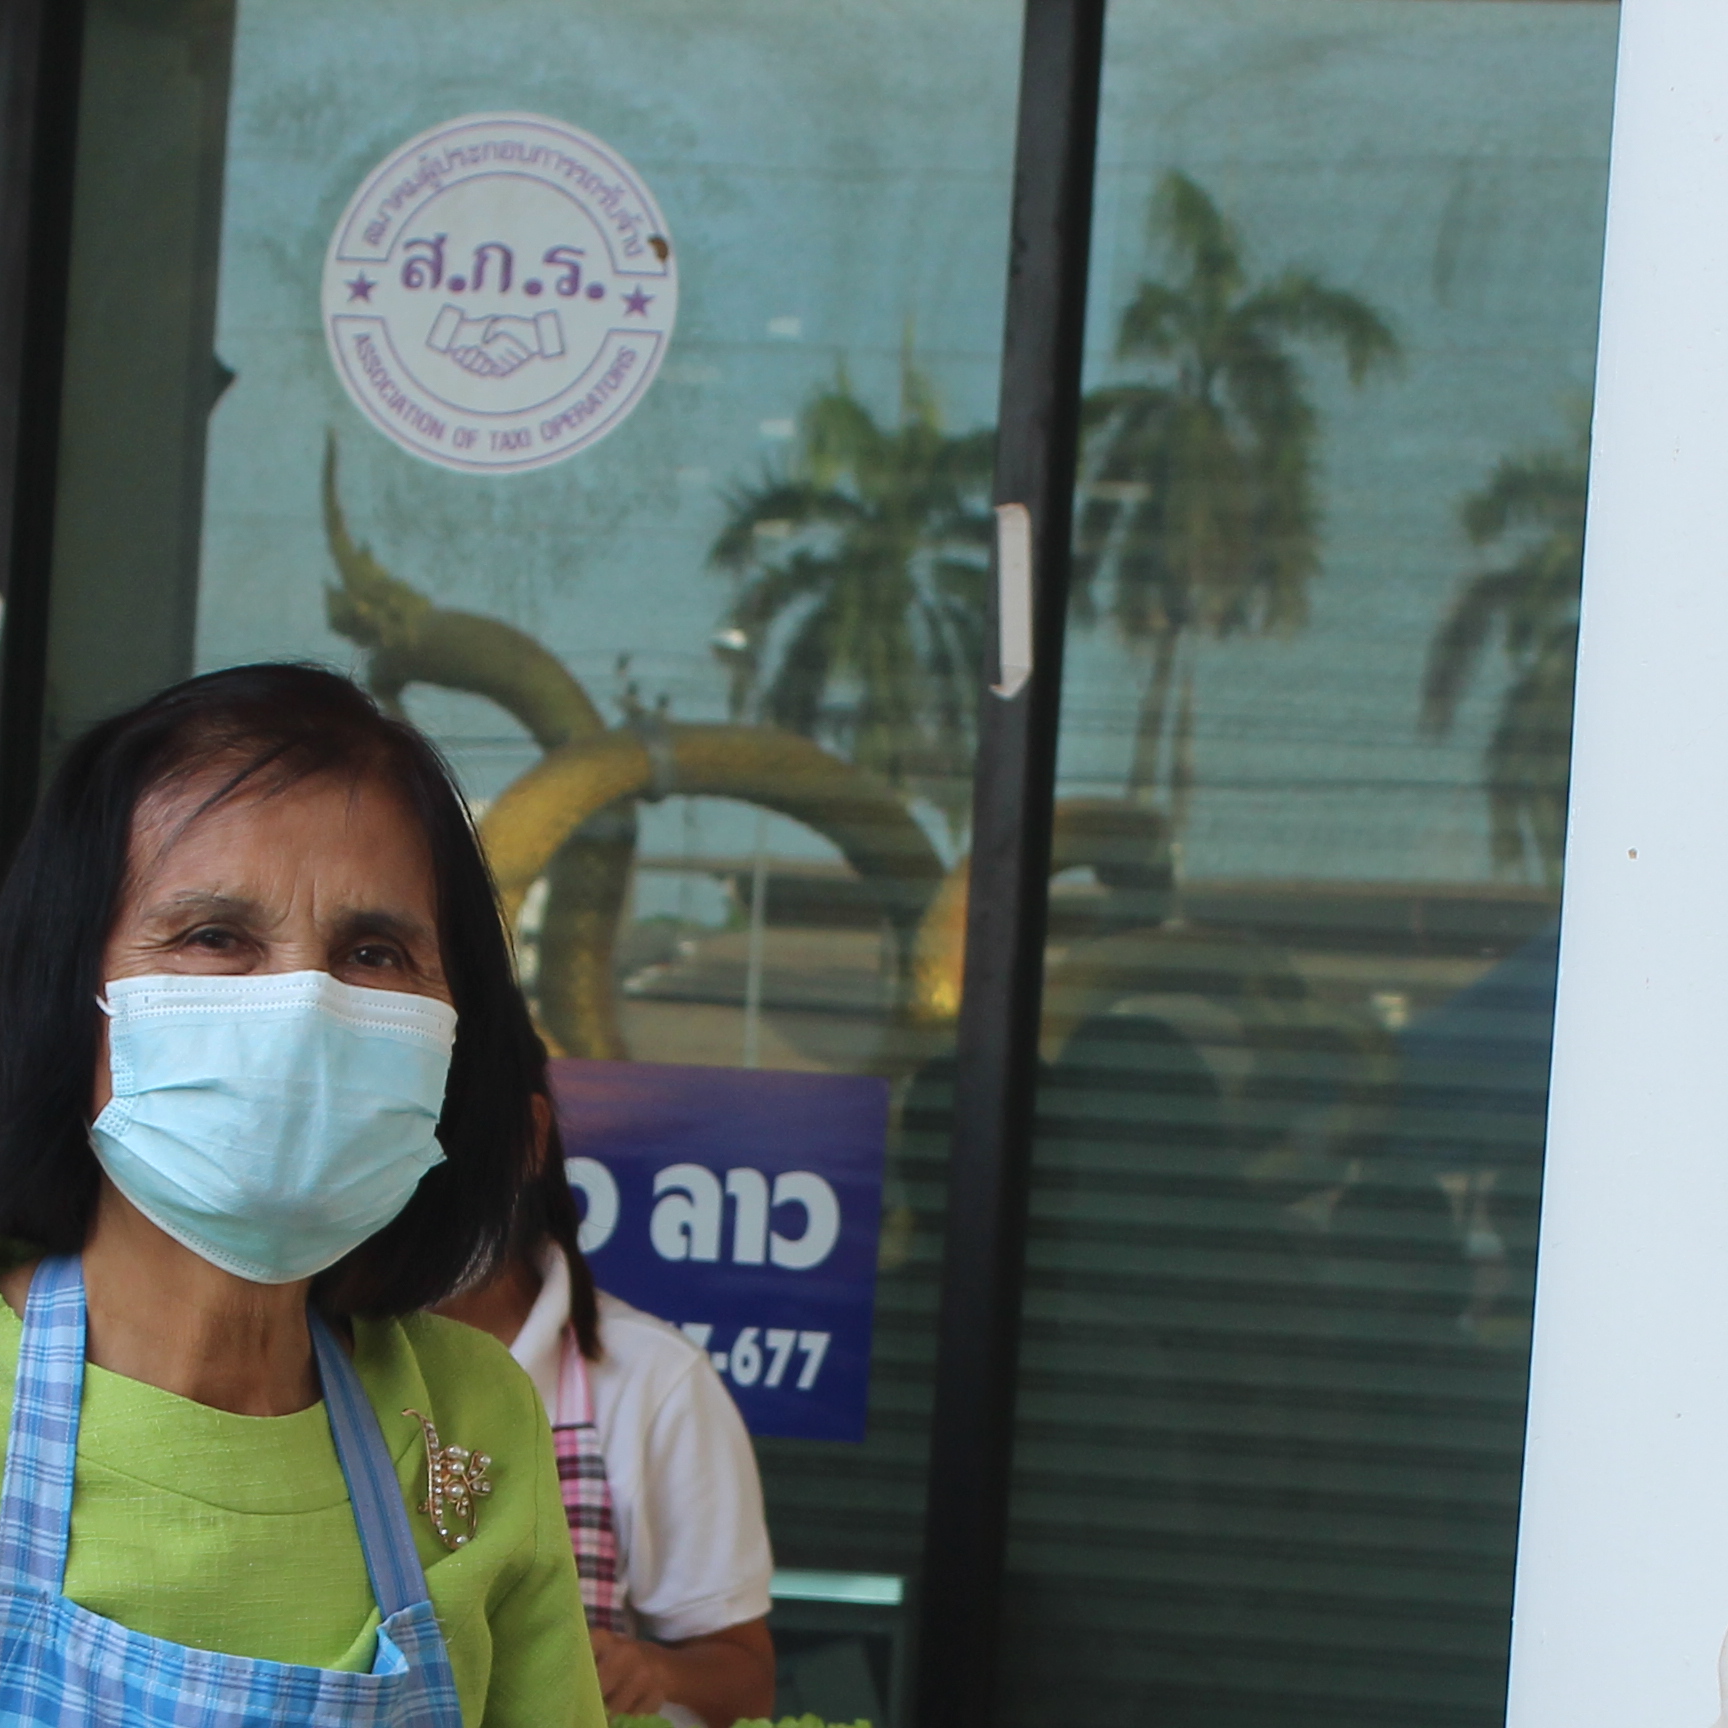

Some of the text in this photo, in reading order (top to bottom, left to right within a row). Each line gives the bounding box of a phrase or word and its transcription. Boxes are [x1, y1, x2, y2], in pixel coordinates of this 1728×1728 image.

[400, 233, 606, 301] ส.ก.ร.
[354, 332, 637, 451] ASSOCIATION OF TAXI OPERATORS
[650, 1163, 841, 1270] ลาว
